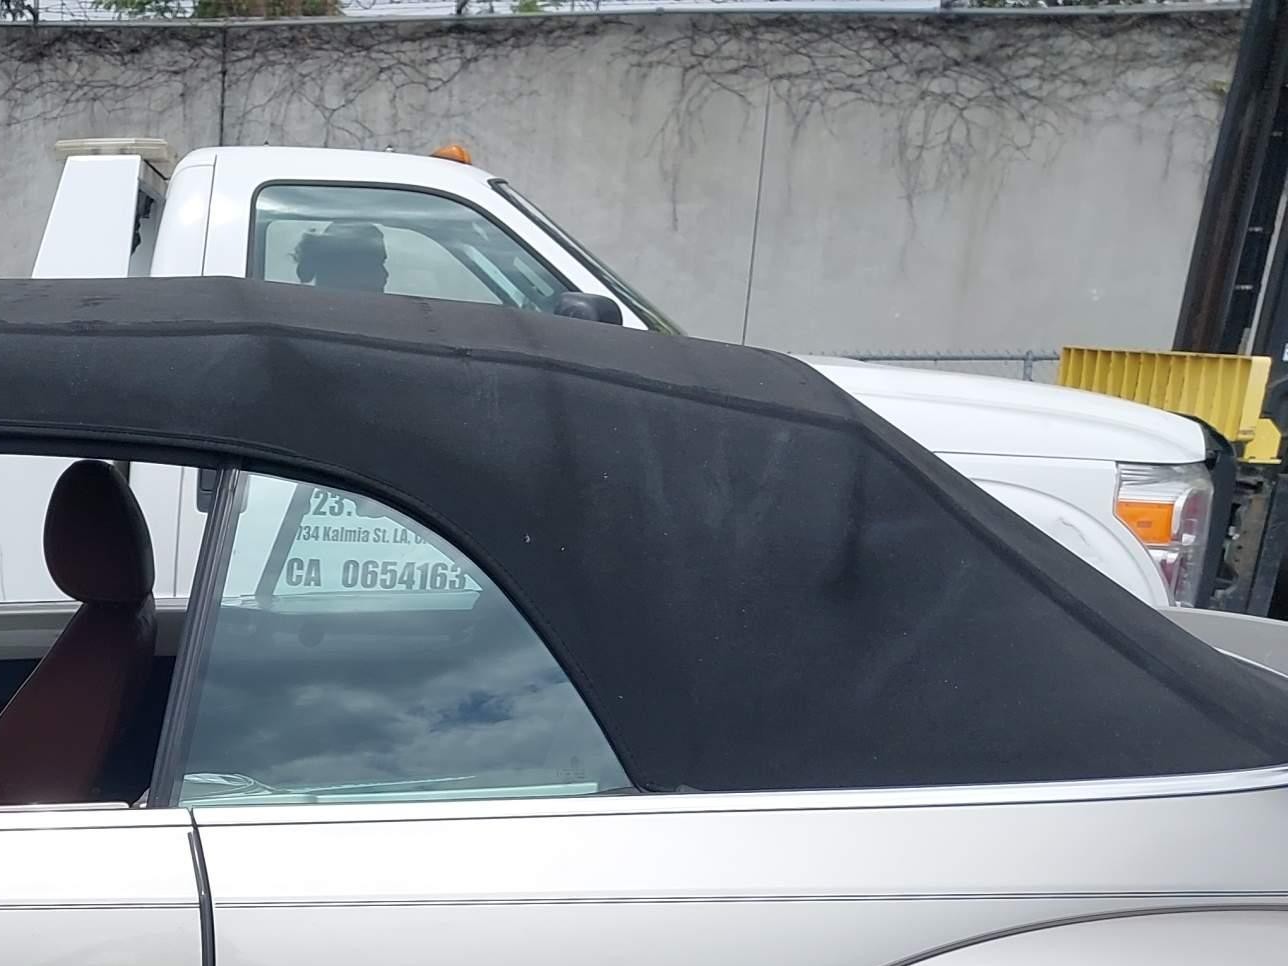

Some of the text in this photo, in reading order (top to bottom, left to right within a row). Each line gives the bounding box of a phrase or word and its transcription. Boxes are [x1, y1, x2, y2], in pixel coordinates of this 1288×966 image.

[323, 525, 370, 543] Kalmia
[373, 527, 390, 544] St.
[285, 557, 466, 591] CA 0654163
